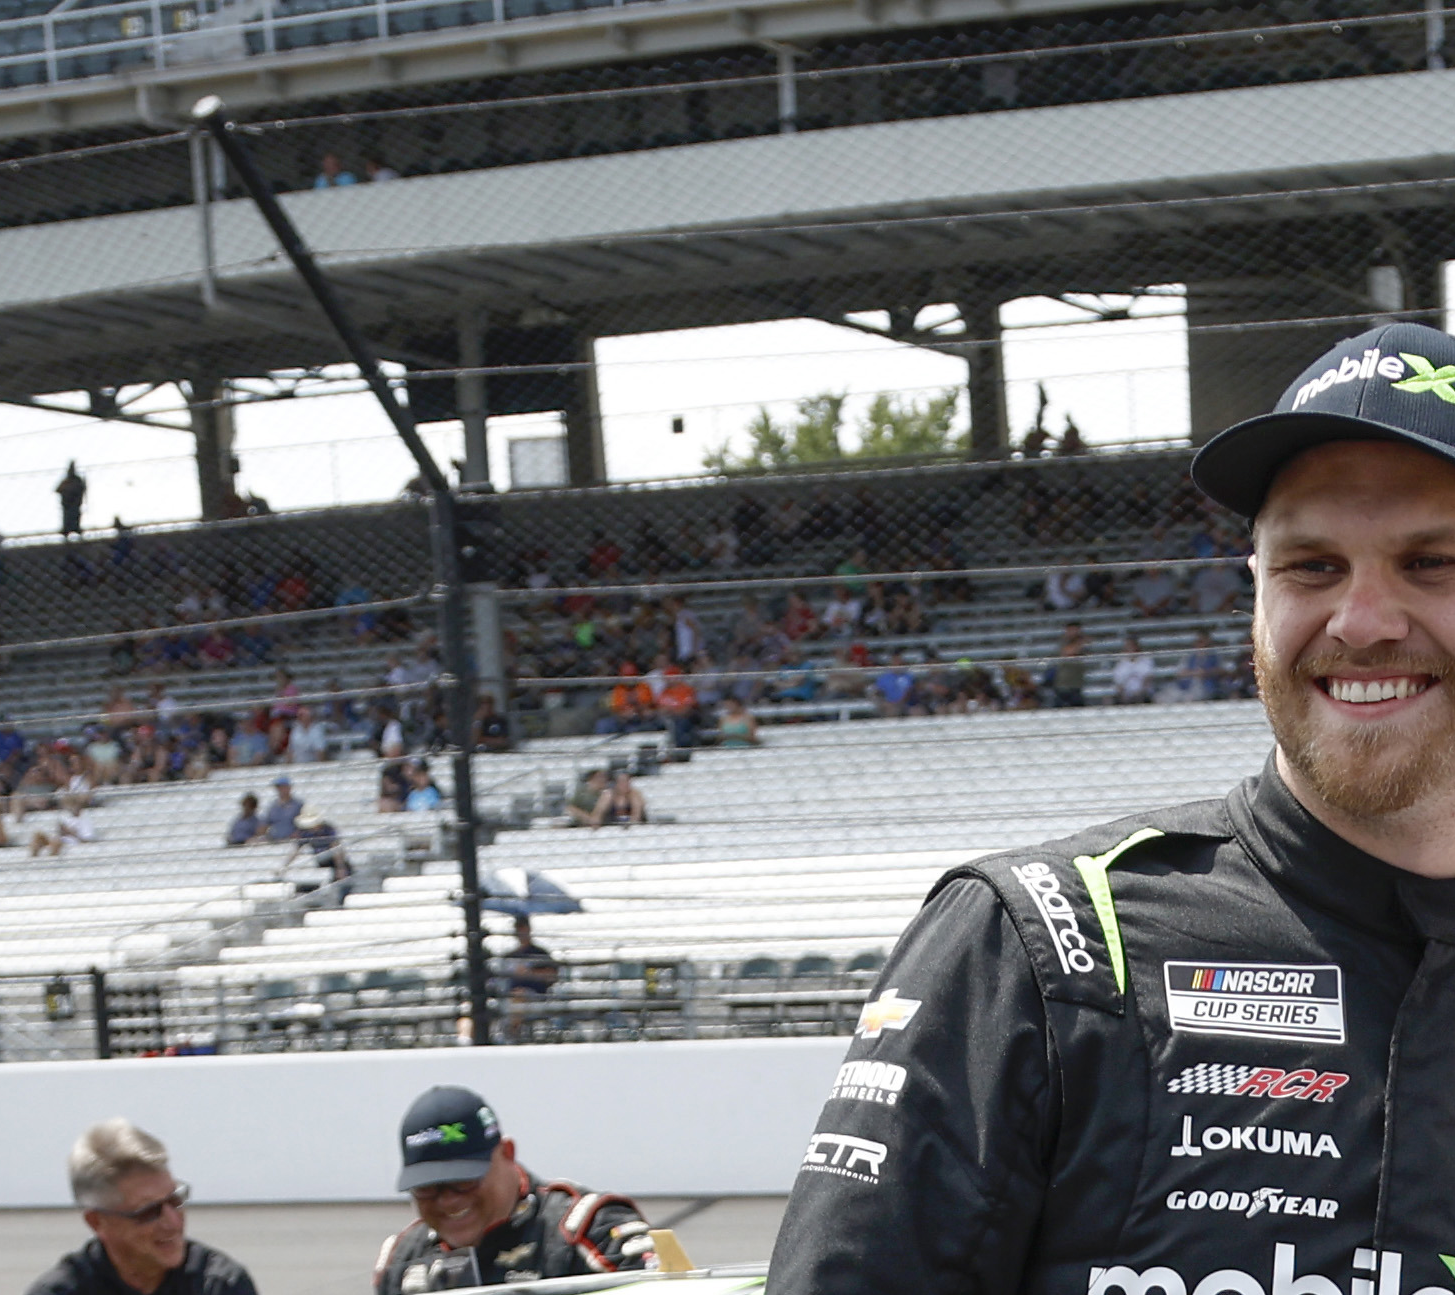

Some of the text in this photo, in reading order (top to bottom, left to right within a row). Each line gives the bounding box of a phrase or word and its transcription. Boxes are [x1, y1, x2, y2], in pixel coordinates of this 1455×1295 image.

[1021, 862, 1094, 973] sparco
[1222, 969, 1315, 994] NASCAR
[1194, 1000, 1319, 1025] CUP SERIES
[834, 1061, 907, 1092] ETHOD
[1237, 1067, 1349, 1102] RCR
